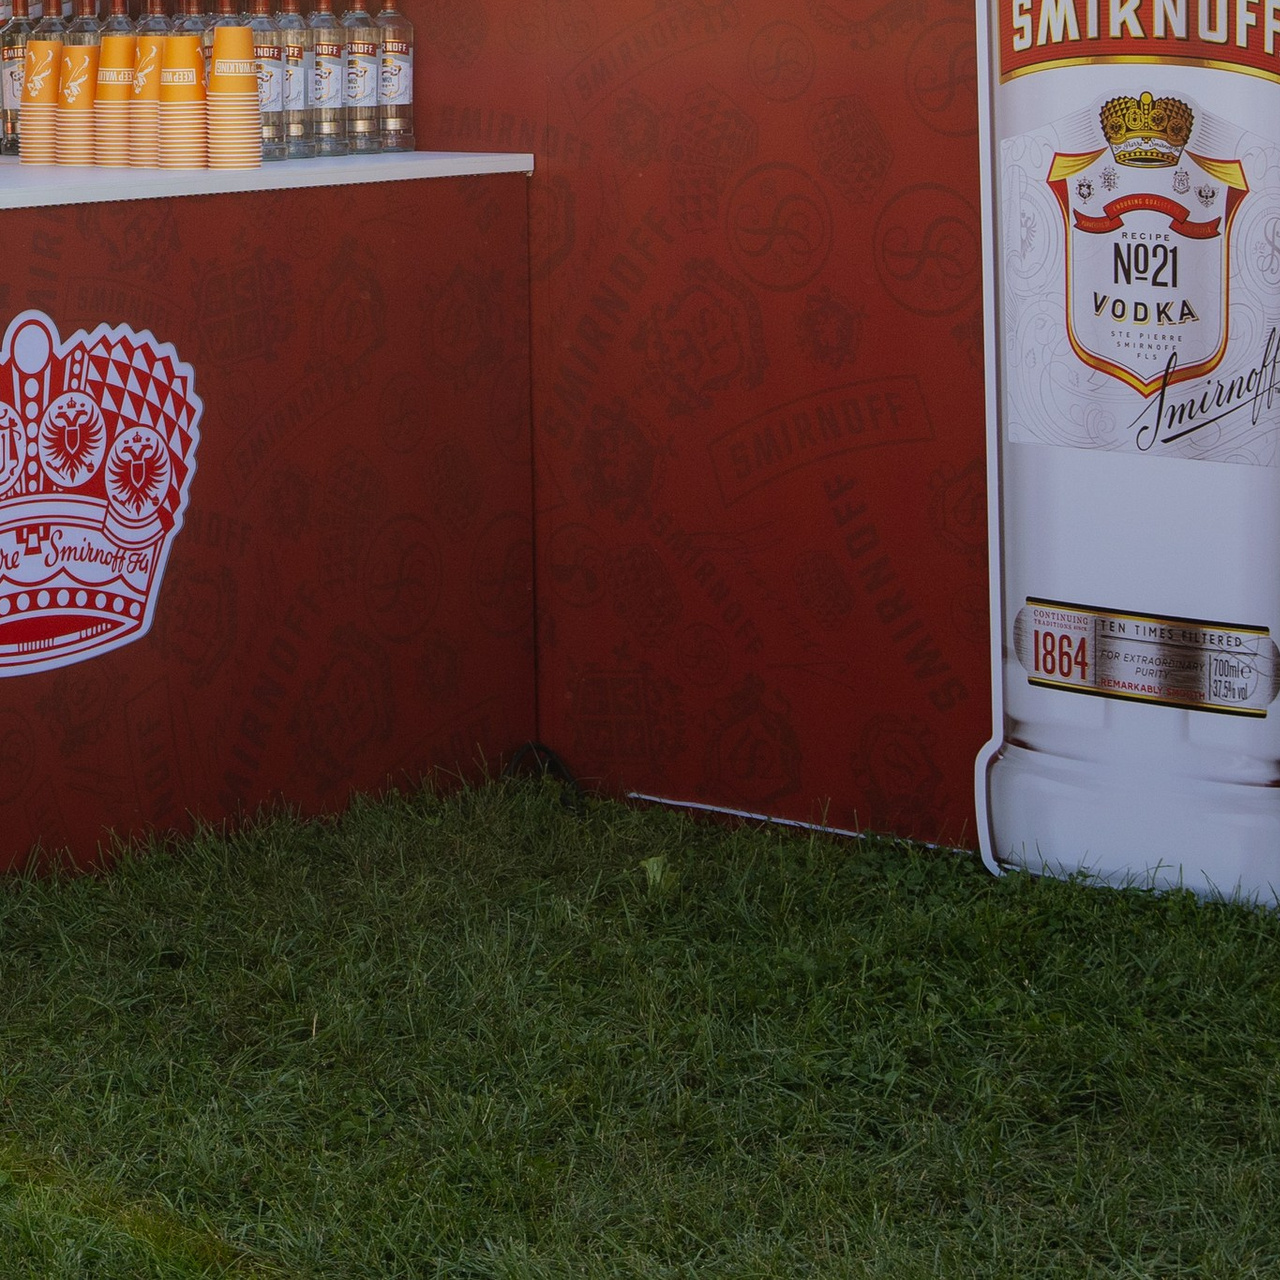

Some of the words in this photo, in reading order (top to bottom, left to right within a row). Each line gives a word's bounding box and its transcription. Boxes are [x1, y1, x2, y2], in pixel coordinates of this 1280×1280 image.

[119, 70, 133, 81] EEP
[1121, 232, 1170, 241] RECIPE
[1093, 291, 1200, 326] VODKA
[1110, 330, 1131, 339] STE
[1139, 332, 1183, 342] PIERRE
[1116, 341, 1177, 351] SMIRNOFF
[1136, 352, 1158, 360] FLS
[44, 529, 127, 574] Smirnoff
[1033, 609, 1089, 626] CONTINUING
[1034, 618, 1072, 630] TRADITIONS
[1100, 620, 1126, 633] TEN
[1134, 624, 1174, 640] TIMES
[1181, 631, 1242, 647] FILTERED
[1033, 629, 1089, 680] 1864
[1100, 650, 1120, 660] FOR
[1123, 654, 1206, 670] EXTRAORDINARY
[1135, 666, 1170, 679] PURITY
[1100, 678, 1163, 695] REMARKABLY
[1166, 688, 1206, 700] SMOOTH
[1237, 682, 1248, 701] vol
